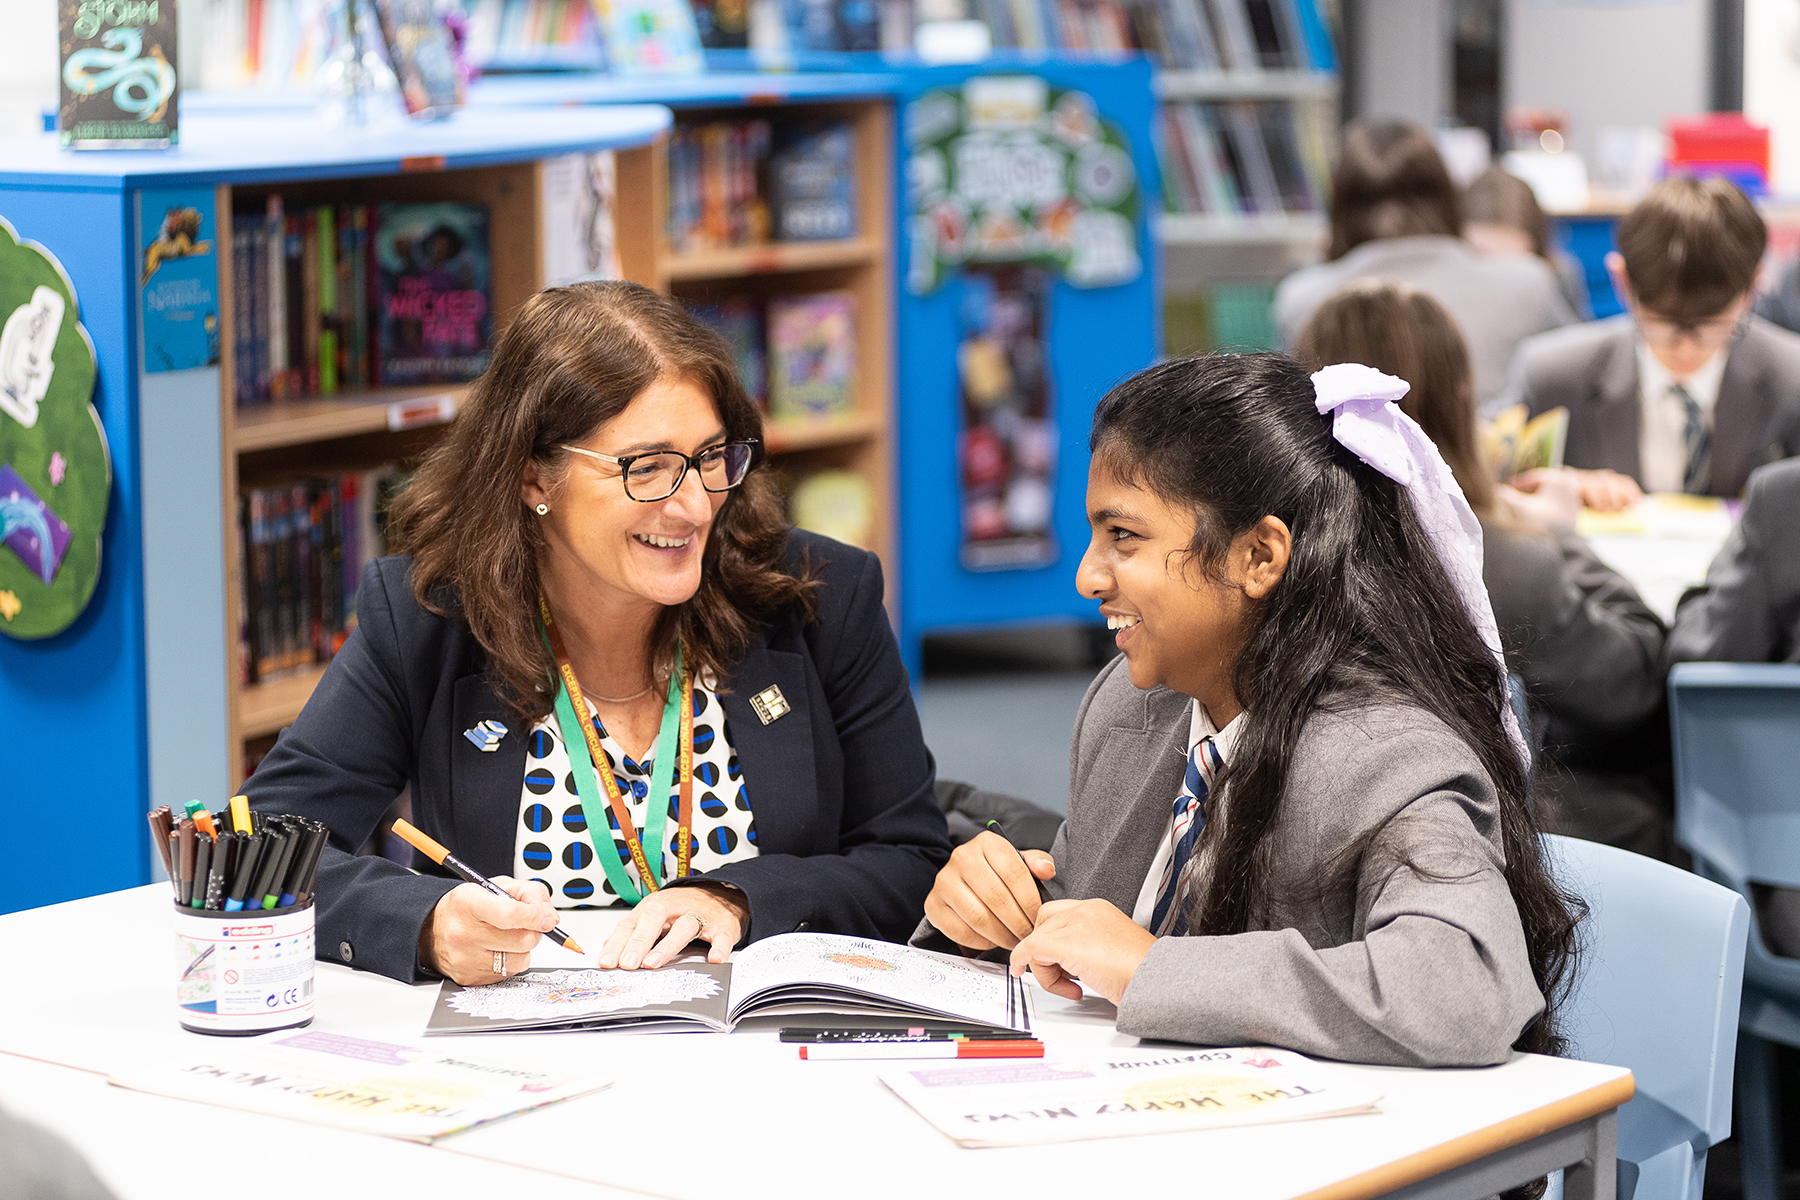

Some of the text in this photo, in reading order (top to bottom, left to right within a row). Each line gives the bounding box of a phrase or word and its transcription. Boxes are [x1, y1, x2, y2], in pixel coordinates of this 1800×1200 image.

[561, 663, 619, 799] EXCEPTIONAL CIRCUMSTANCES
[680, 719, 691, 783] EXCEPTIONAL
[628, 837, 658, 893] EXCEPTIONA
[1105, 1051, 1232, 1070] GRATITUDE
[1095, 1096, 1225, 1115] HAPPY
[1237, 1085, 1327, 1103] THE
